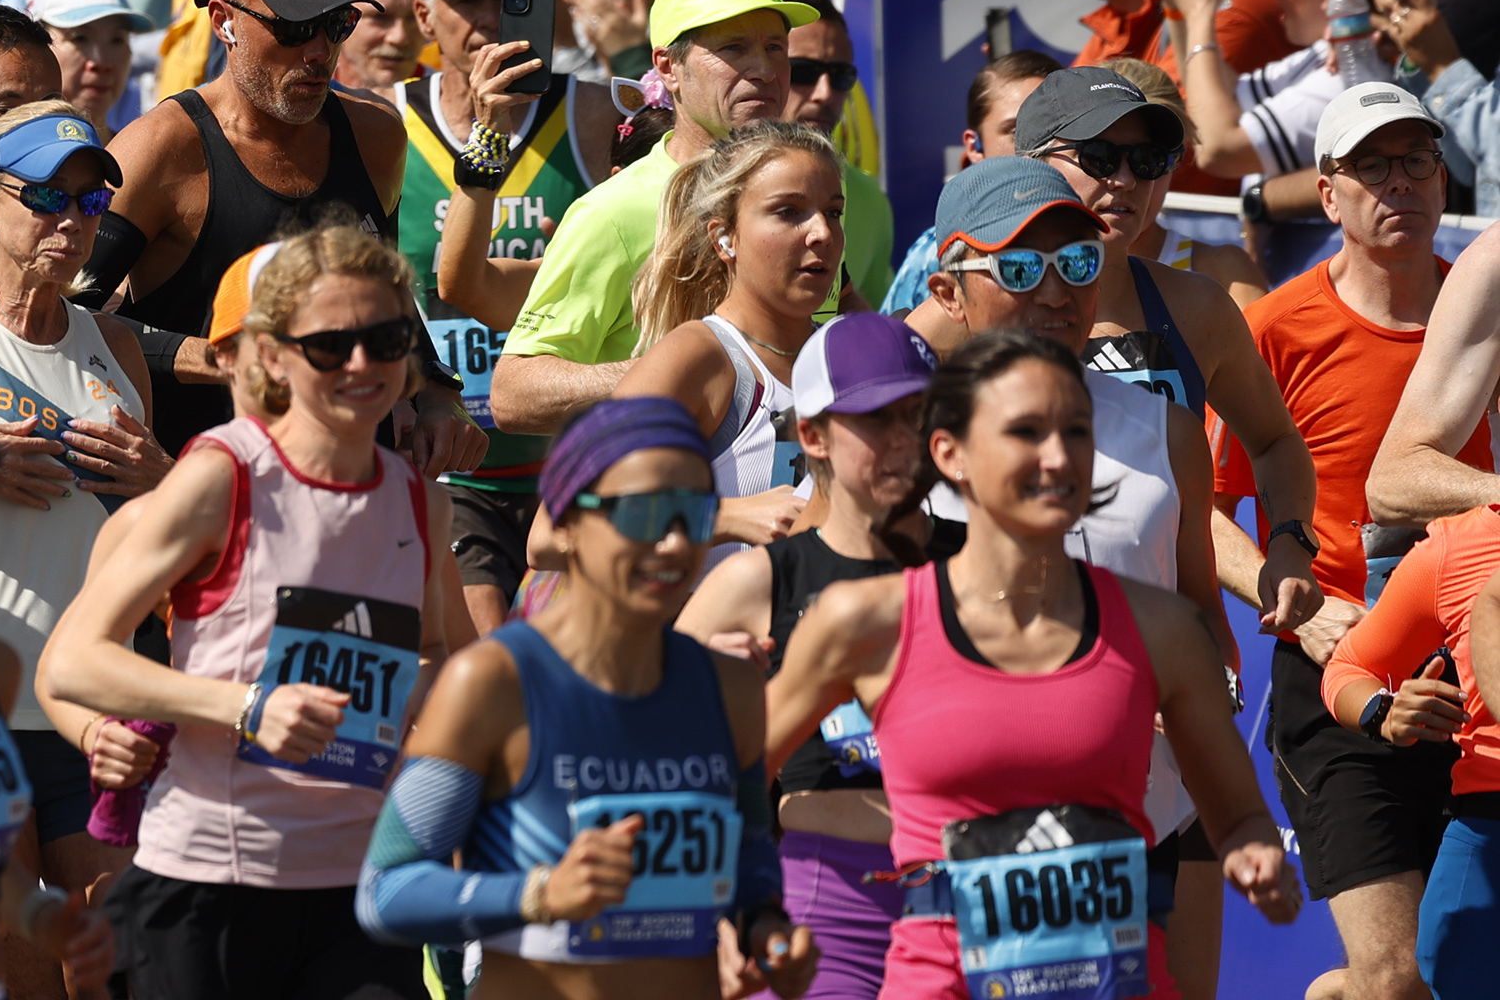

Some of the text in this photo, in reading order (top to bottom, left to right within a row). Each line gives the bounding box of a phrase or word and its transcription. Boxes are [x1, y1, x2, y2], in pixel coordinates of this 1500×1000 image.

[86, 378, 121, 401] 24
[276, 639, 401, 718] 16451
[552, 753, 733, 792] ECUADOR
[973, 855, 1134, 938] 16035
